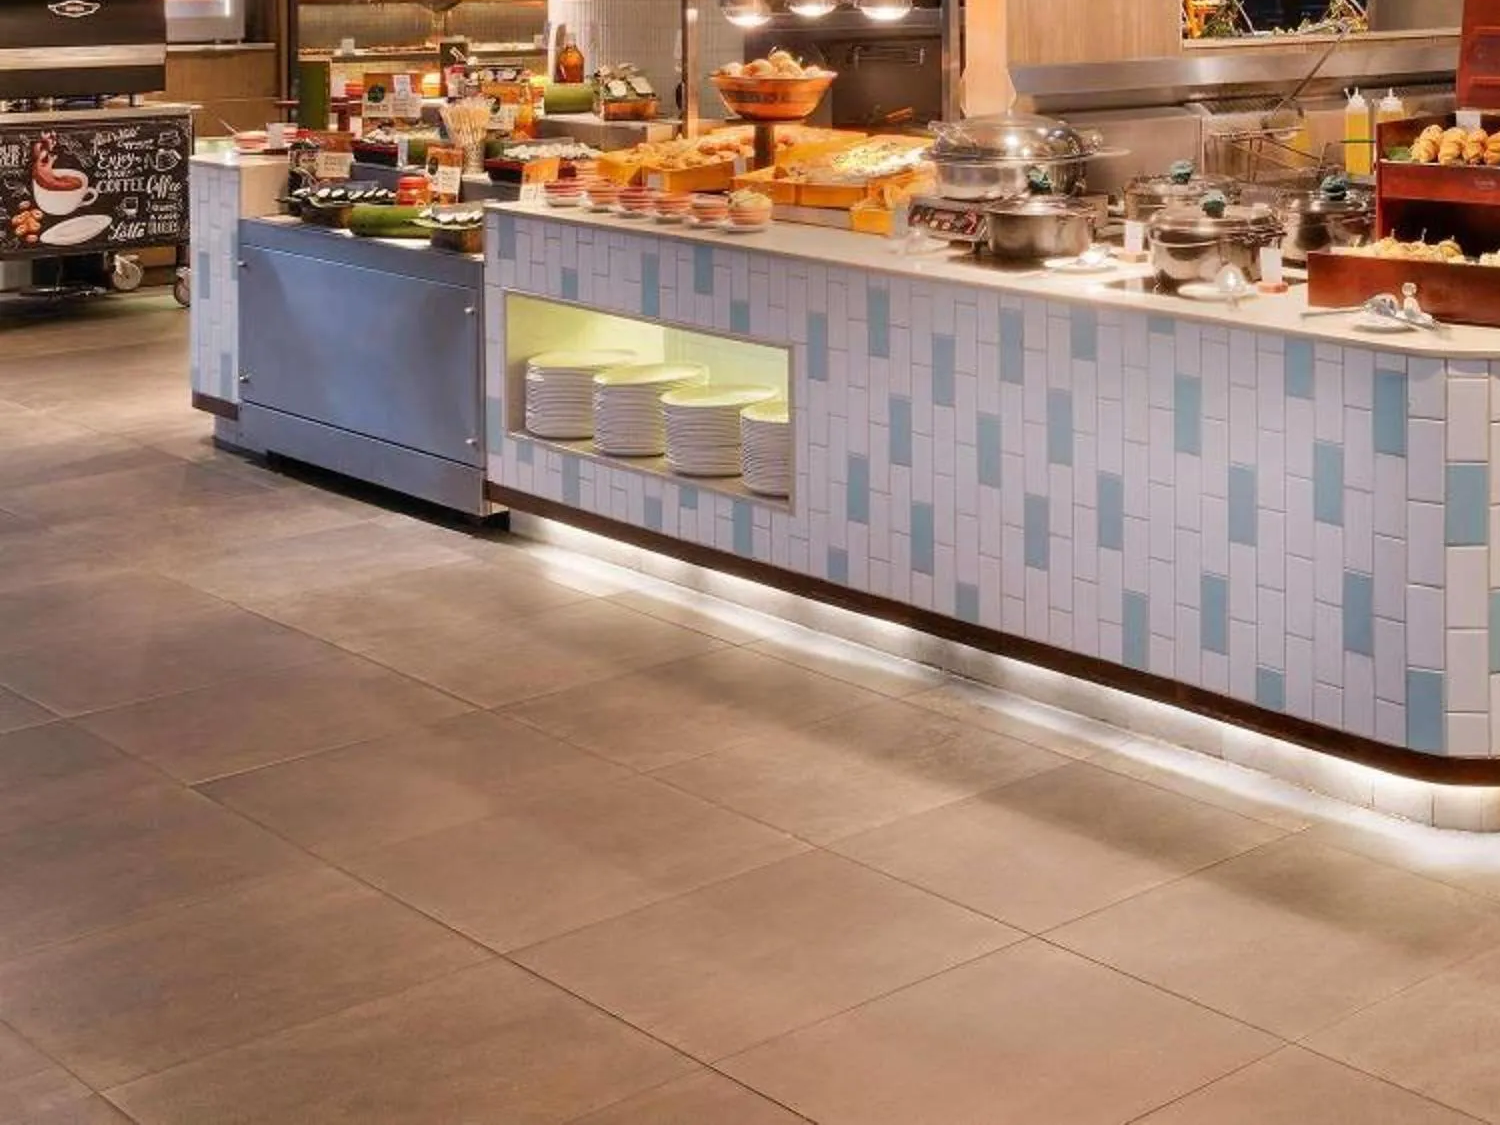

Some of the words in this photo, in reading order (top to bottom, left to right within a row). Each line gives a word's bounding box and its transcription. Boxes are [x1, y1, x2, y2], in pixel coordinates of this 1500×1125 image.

[96, 176, 146, 193] COFFEE
[146, 174, 182, 199] Coffee
[108, 220, 147, 242] Latte
